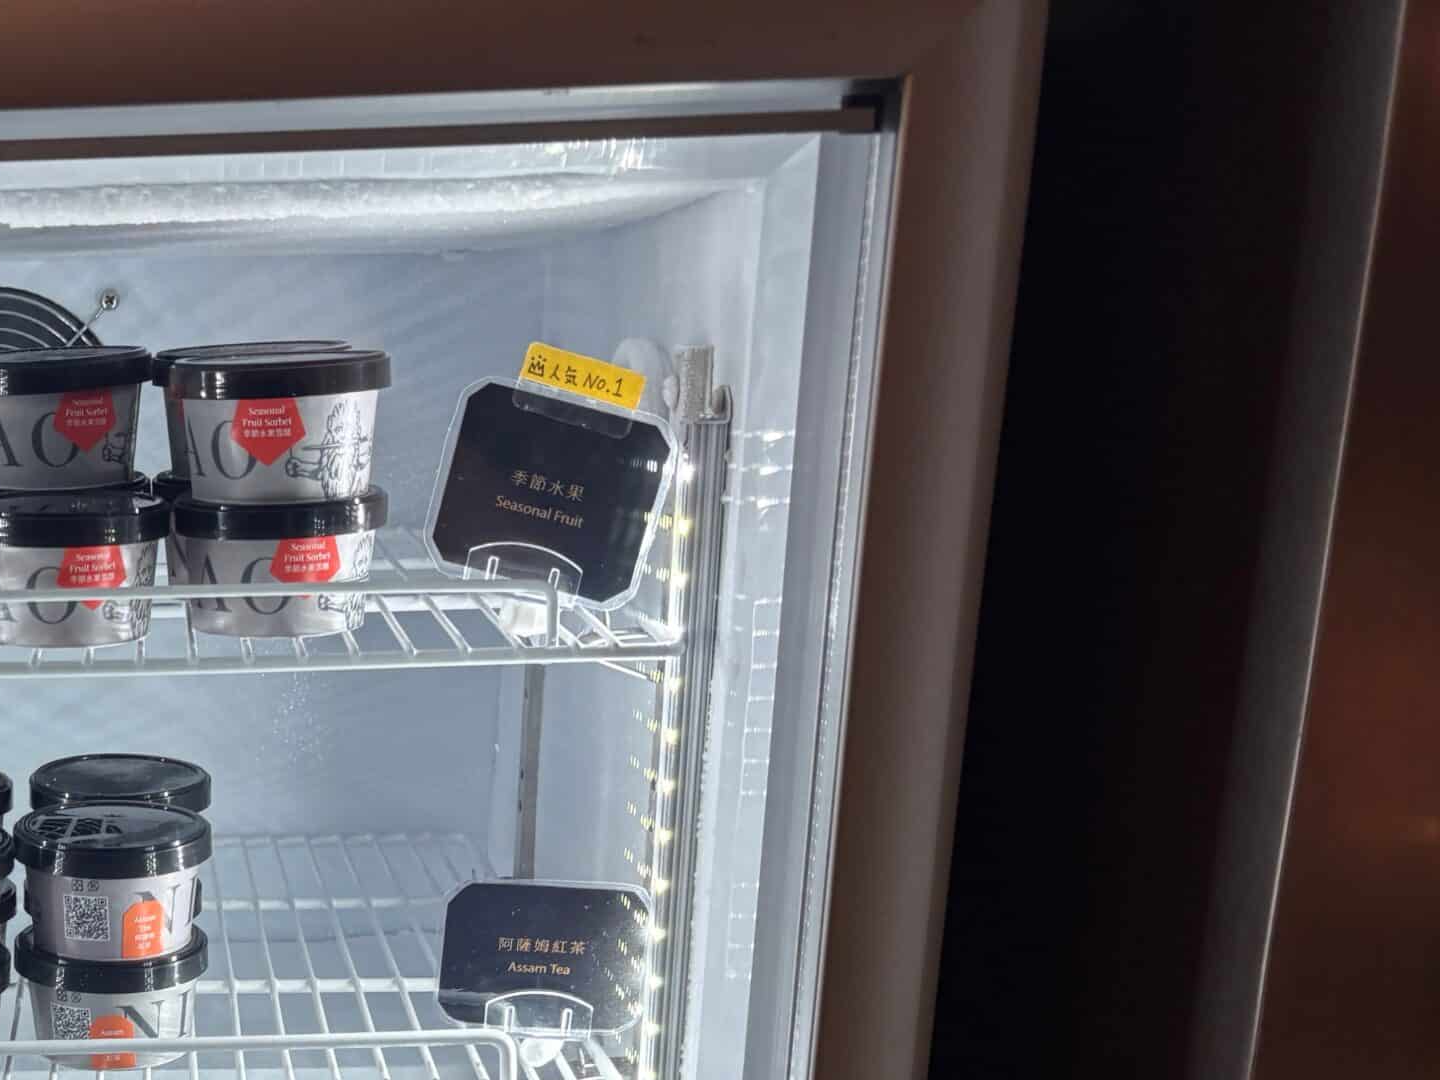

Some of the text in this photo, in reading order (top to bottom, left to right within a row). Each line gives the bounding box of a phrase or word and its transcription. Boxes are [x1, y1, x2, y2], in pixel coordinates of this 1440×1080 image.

[549, 366, 578, 386] 人気
[241, 418, 262, 427] Fruit
[511, 469, 585, 502] 季節水果
[495, 495, 584, 529] Seasonal Fruit
[284, 552, 303, 563] Fruit
[498, 936, 586, 955] 阿薩姆紅茶
[508, 961, 570, 976] Assam Tea
